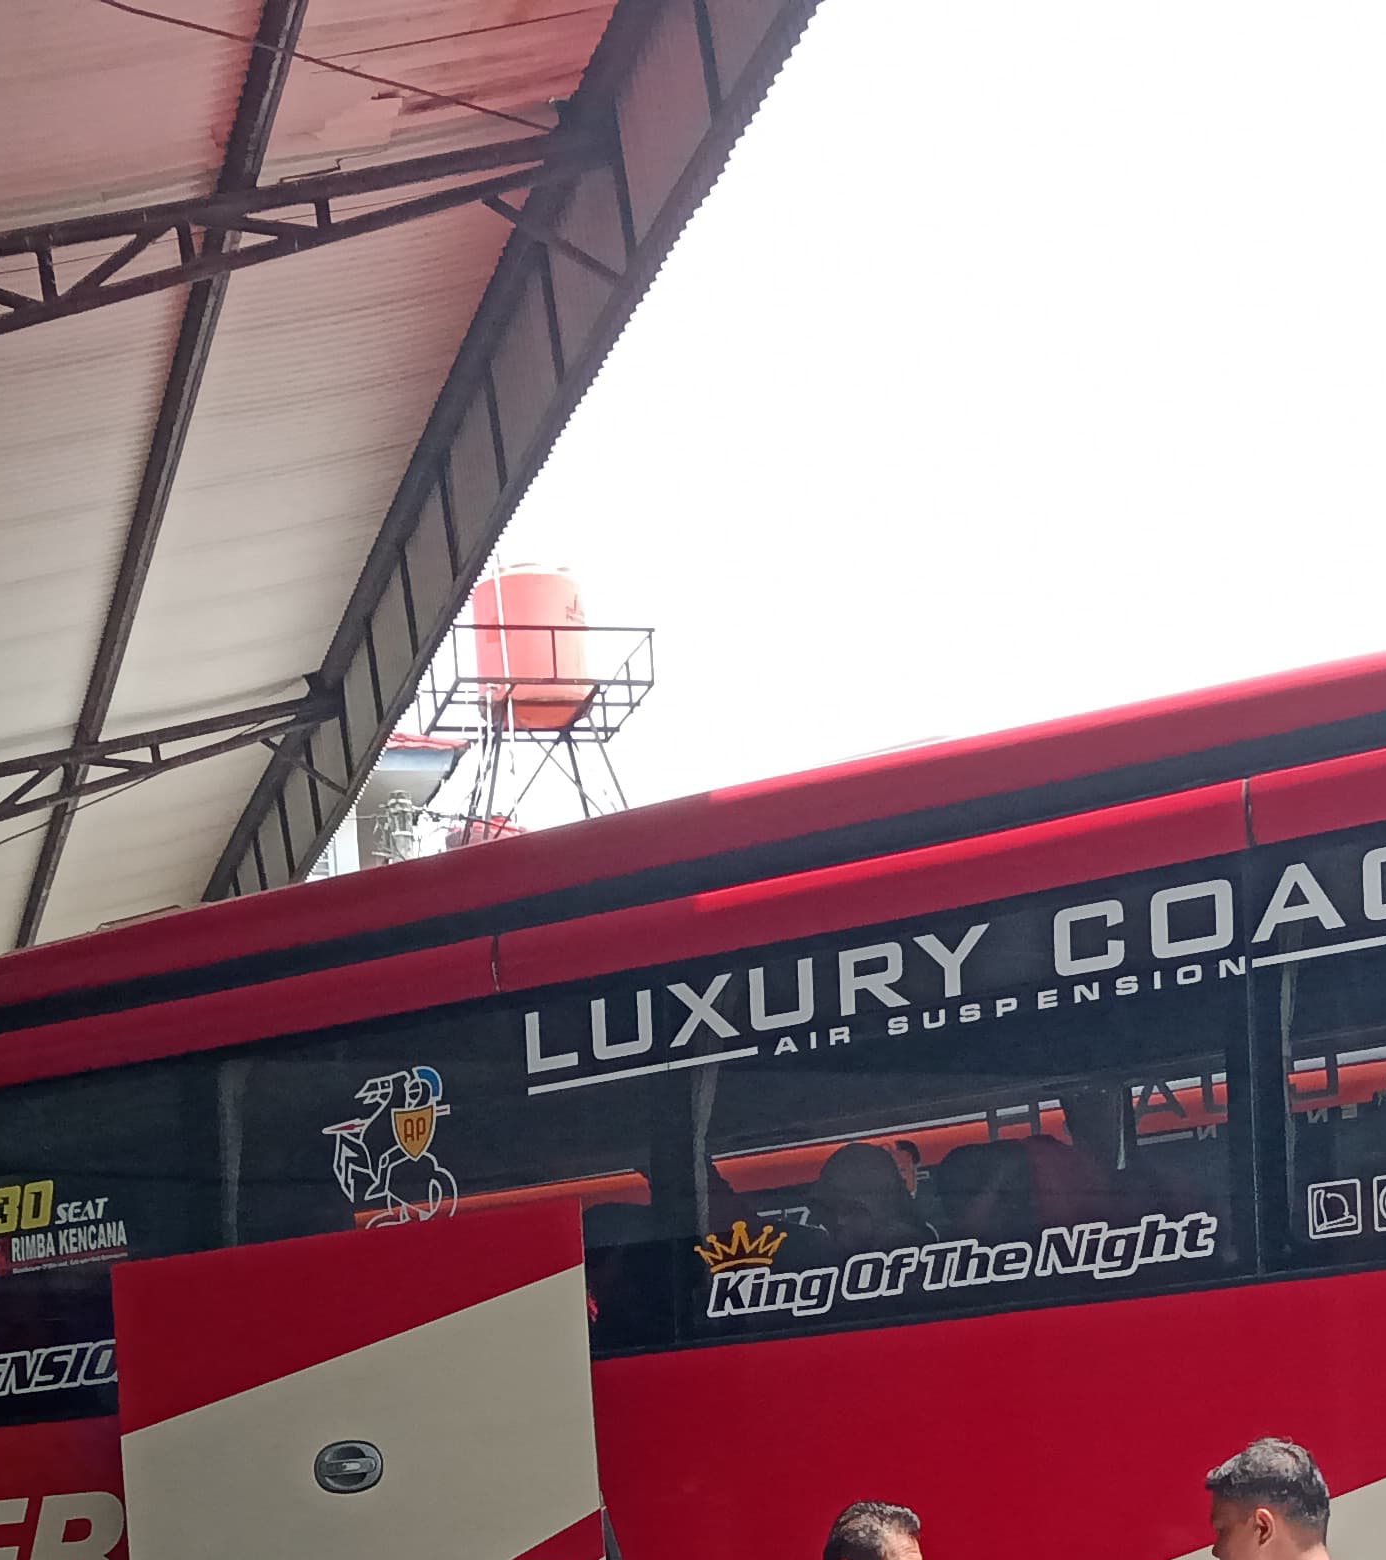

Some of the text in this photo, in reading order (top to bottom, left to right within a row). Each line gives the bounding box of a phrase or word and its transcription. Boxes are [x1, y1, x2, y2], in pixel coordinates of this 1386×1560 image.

[524, 922, 991, 1074] LUXURY
[773, 955, 1247, 1057] AIR SUSPENSION
[403, 1116, 426, 1143] AP
[11, 1220, 128, 1263] RIMBA KENCANA
[54, 1197, 109, 1225] SEAT
[706, 1210, 1218, 1318] King Of The Night
